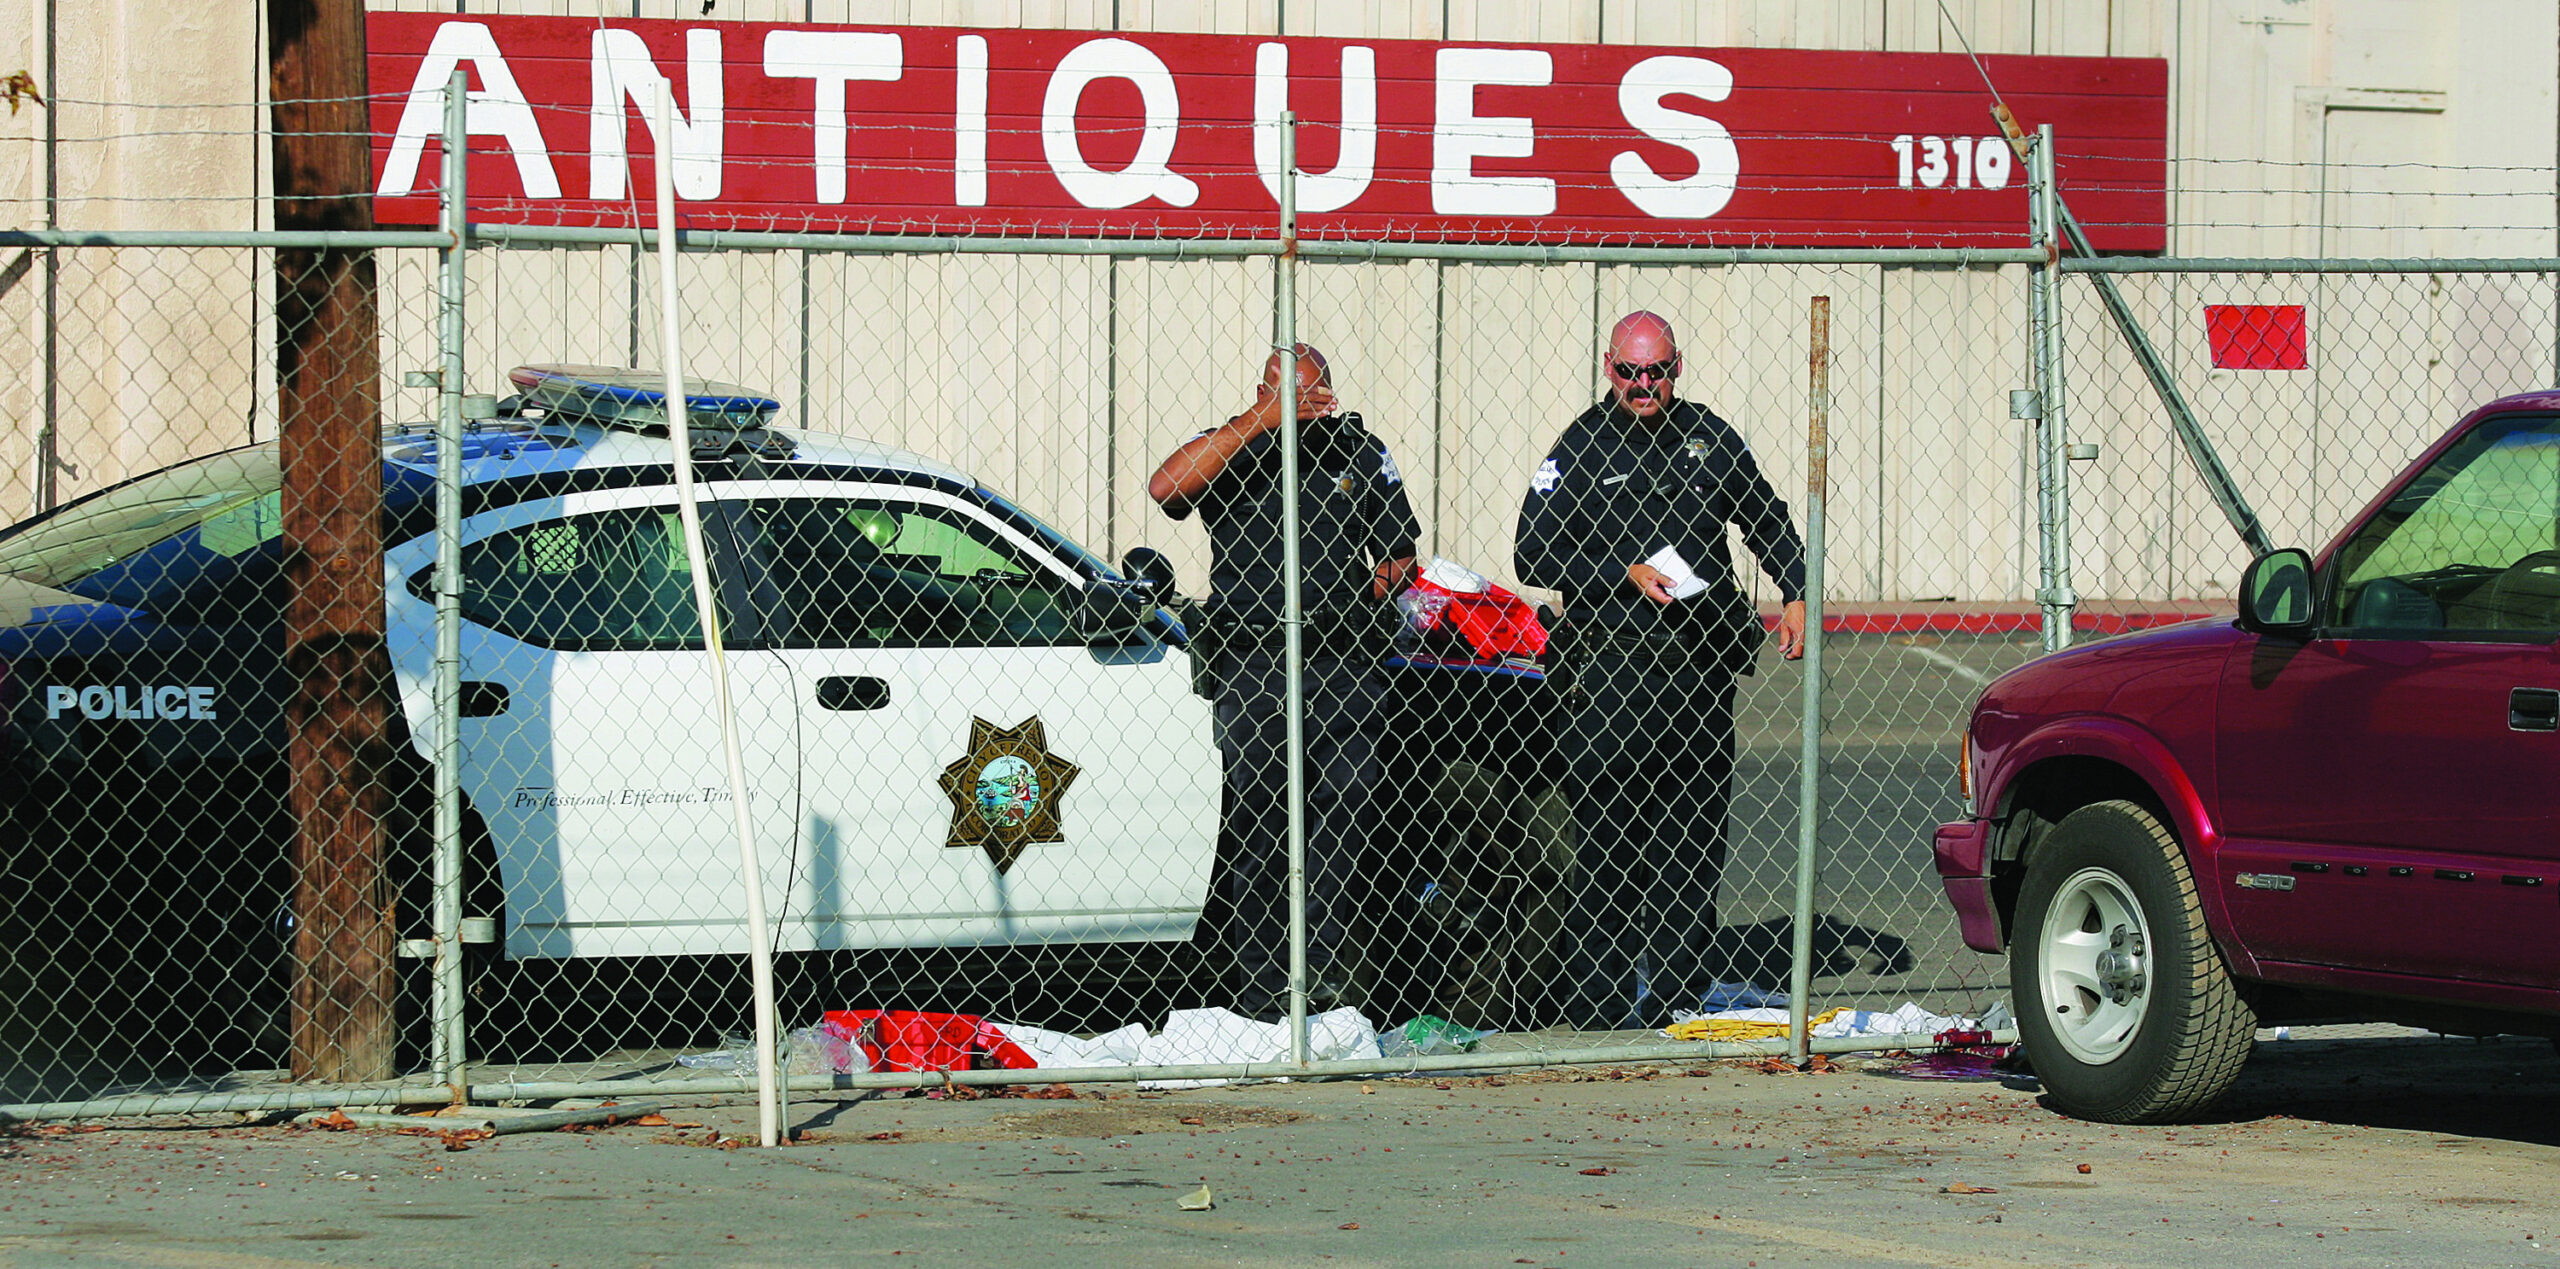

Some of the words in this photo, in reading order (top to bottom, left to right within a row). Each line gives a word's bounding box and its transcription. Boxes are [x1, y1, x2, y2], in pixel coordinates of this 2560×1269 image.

[376, 22, 1740, 219] ANTIQUES
[1891, 134, 2011, 190] 1310
[47, 685, 217, 720] POLICE
